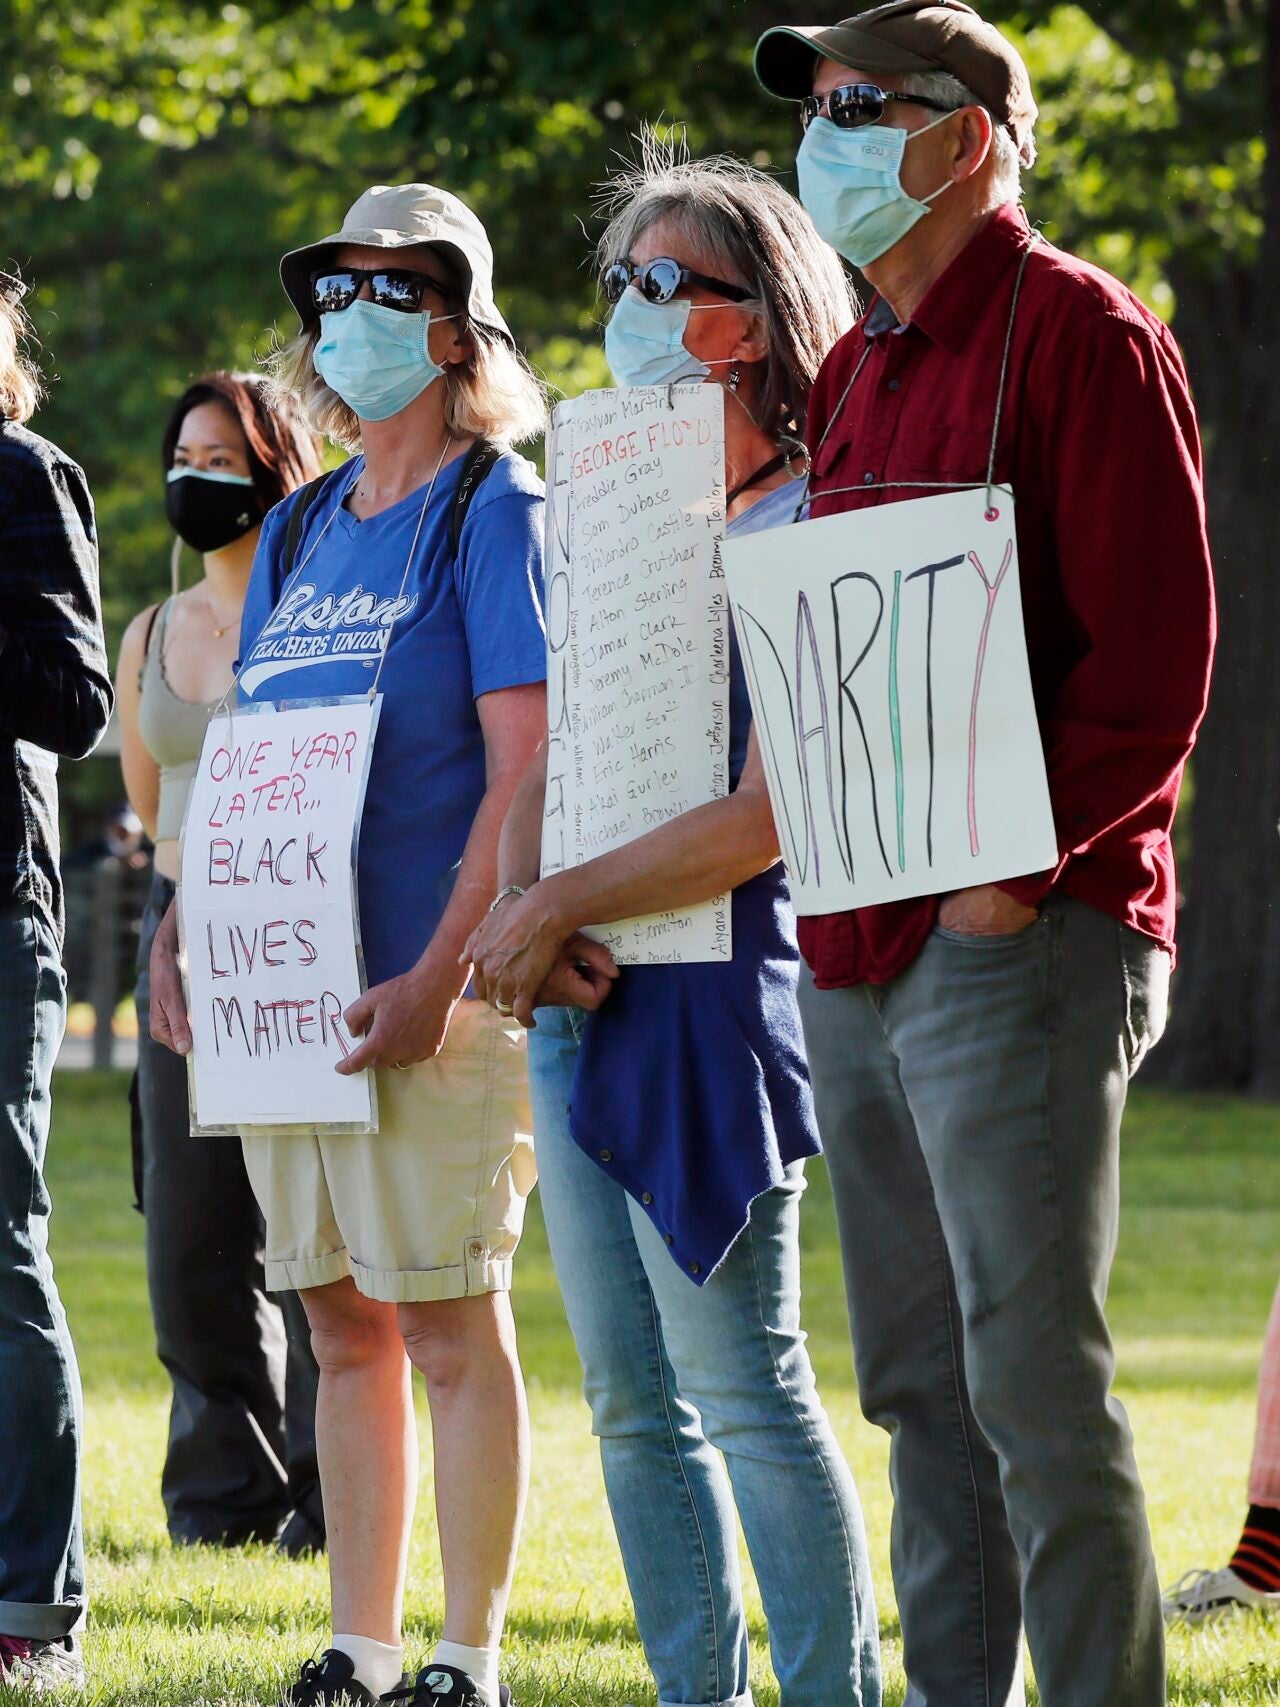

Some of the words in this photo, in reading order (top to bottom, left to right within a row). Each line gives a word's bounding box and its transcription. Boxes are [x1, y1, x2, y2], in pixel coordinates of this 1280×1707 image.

[622, 397, 670, 419] Martin
[458, 446, 492, 504] sprey
[571, 431, 641, 479] GEORGE
[625, 457, 663, 484] Gray
[582, 520, 610, 546] Sam
[617, 488, 672, 524] Dubose
[647, 509, 694, 543] Castile
[706, 477, 725, 528] Taylor
[582, 573, 631, 604] Terence
[640, 542, 700, 579] Crutcher
[260, 583, 418, 640] Boston
[589, 608, 626, 633] Alton
[634, 579, 688, 612] Sterling
[707, 594, 728, 622] Lyles
[249, 634, 331, 661] TEACHERS
[331, 629, 390, 653] UNION
[582, 632, 629, 668] Jamar
[639, 615, 687, 641] Clark
[709, 627, 727, 685] Charleena
[585, 664, 632, 695] Jeremy
[580, 702, 617, 734] William
[210, 740, 273, 782] ONE
[291, 731, 357, 775] YEAR
[574, 744, 584, 788] Williams
[593, 760, 624, 785] Eric
[630, 736, 676, 768] Harris
[626, 769, 681, 800] Gurley
[208, 831, 329, 888] BLACK
[207, 919, 318, 979] LIVES
[647, 949, 682, 963] Daniels
[211, 990, 352, 1060] MATTER
